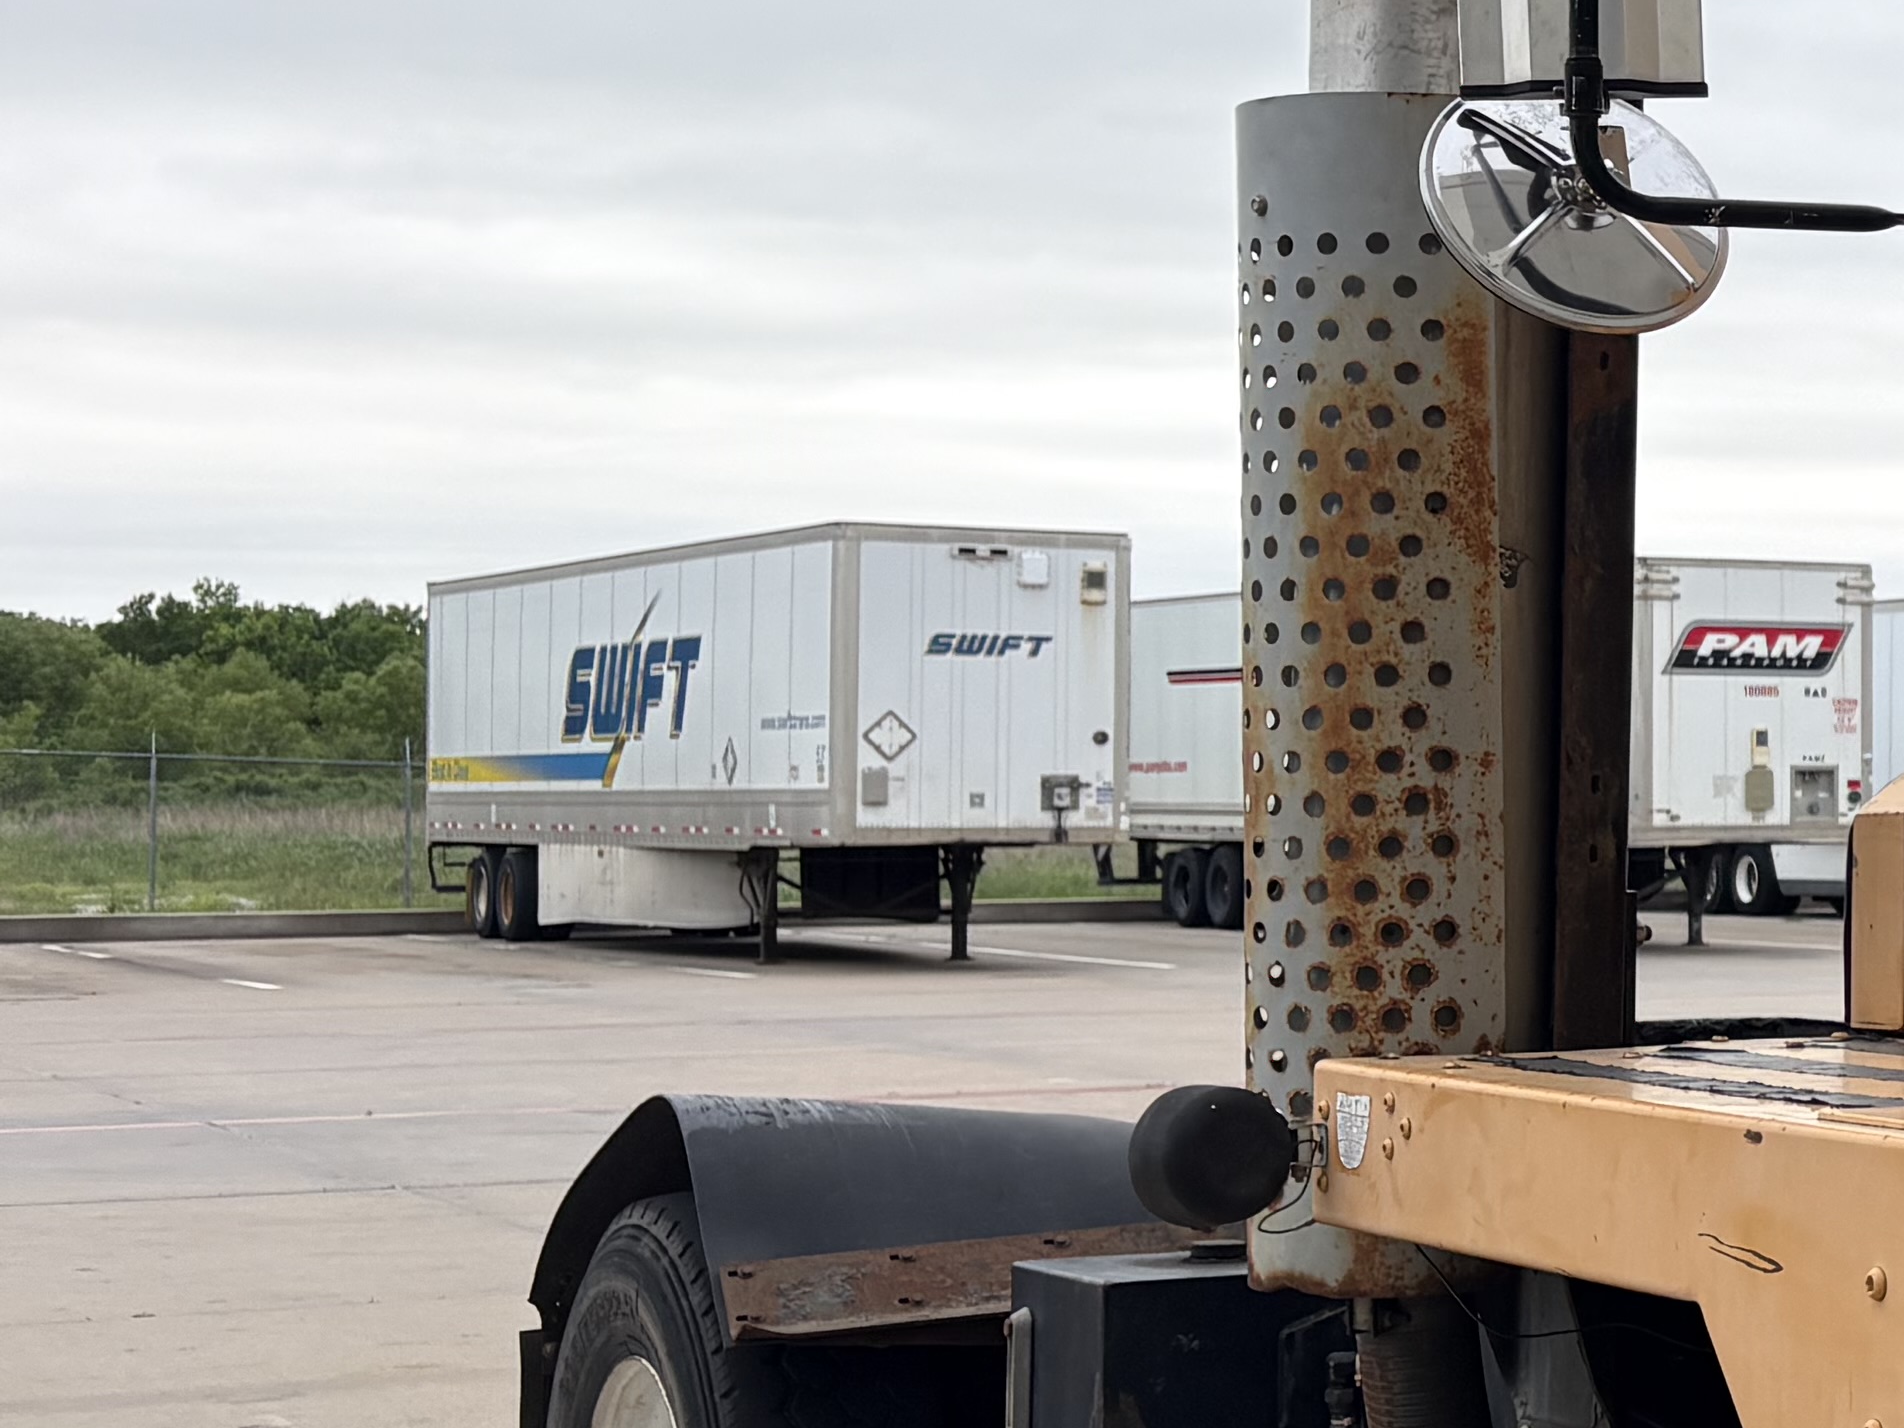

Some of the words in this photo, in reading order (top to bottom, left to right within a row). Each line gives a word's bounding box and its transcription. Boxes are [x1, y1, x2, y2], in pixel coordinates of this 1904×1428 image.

[924, 632, 1053, 659] SWIFT
[1697, 632, 1824, 659] PAM
[560, 634, 702, 744] SWIFT
